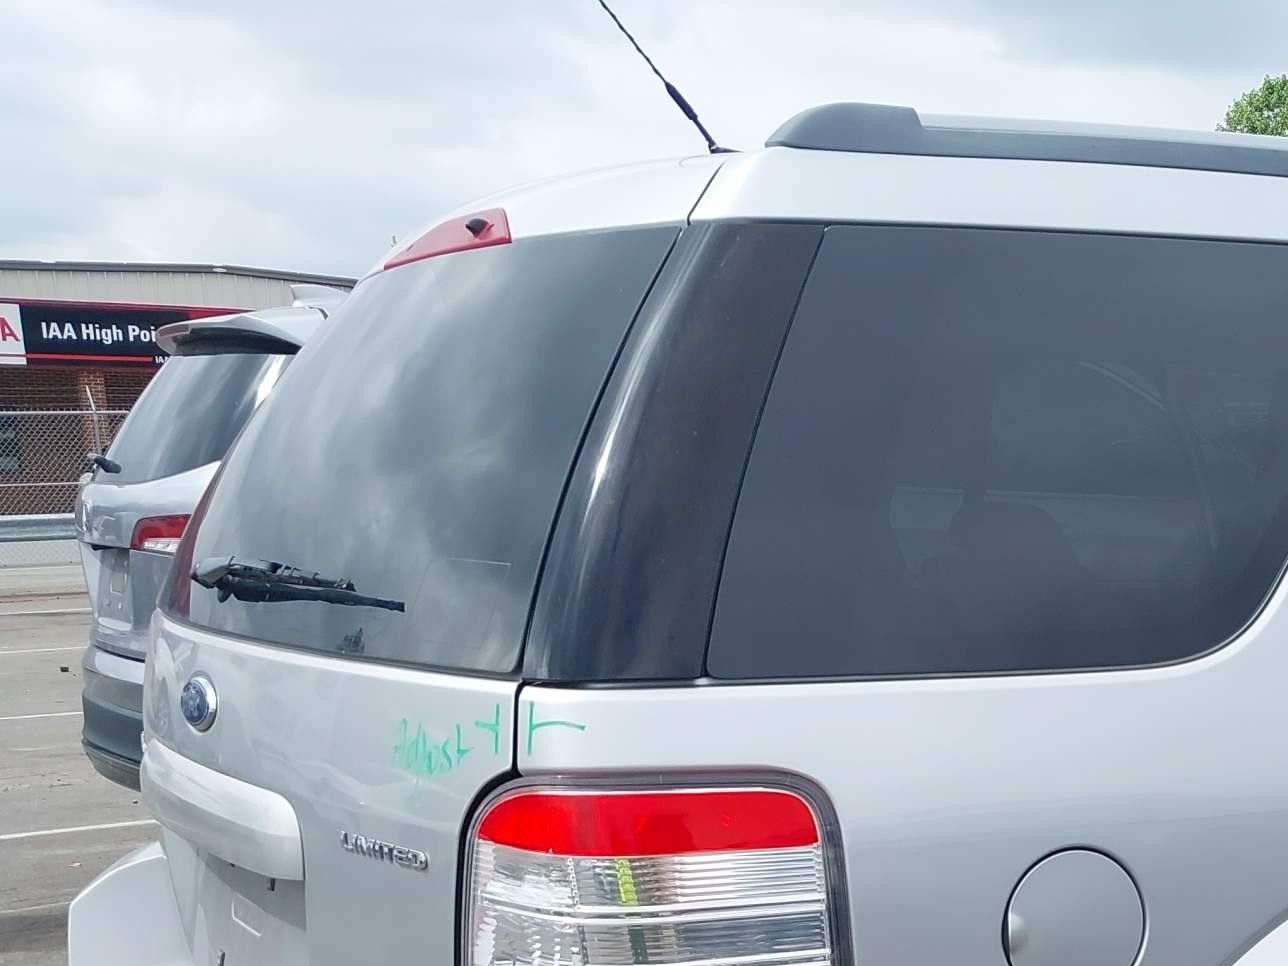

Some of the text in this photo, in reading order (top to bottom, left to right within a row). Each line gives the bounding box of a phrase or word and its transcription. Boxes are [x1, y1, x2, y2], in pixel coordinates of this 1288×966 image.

[41, 322, 78, 340] IAA
[81, 323, 123, 345] High
[340, 830, 430, 870] LIMITED
